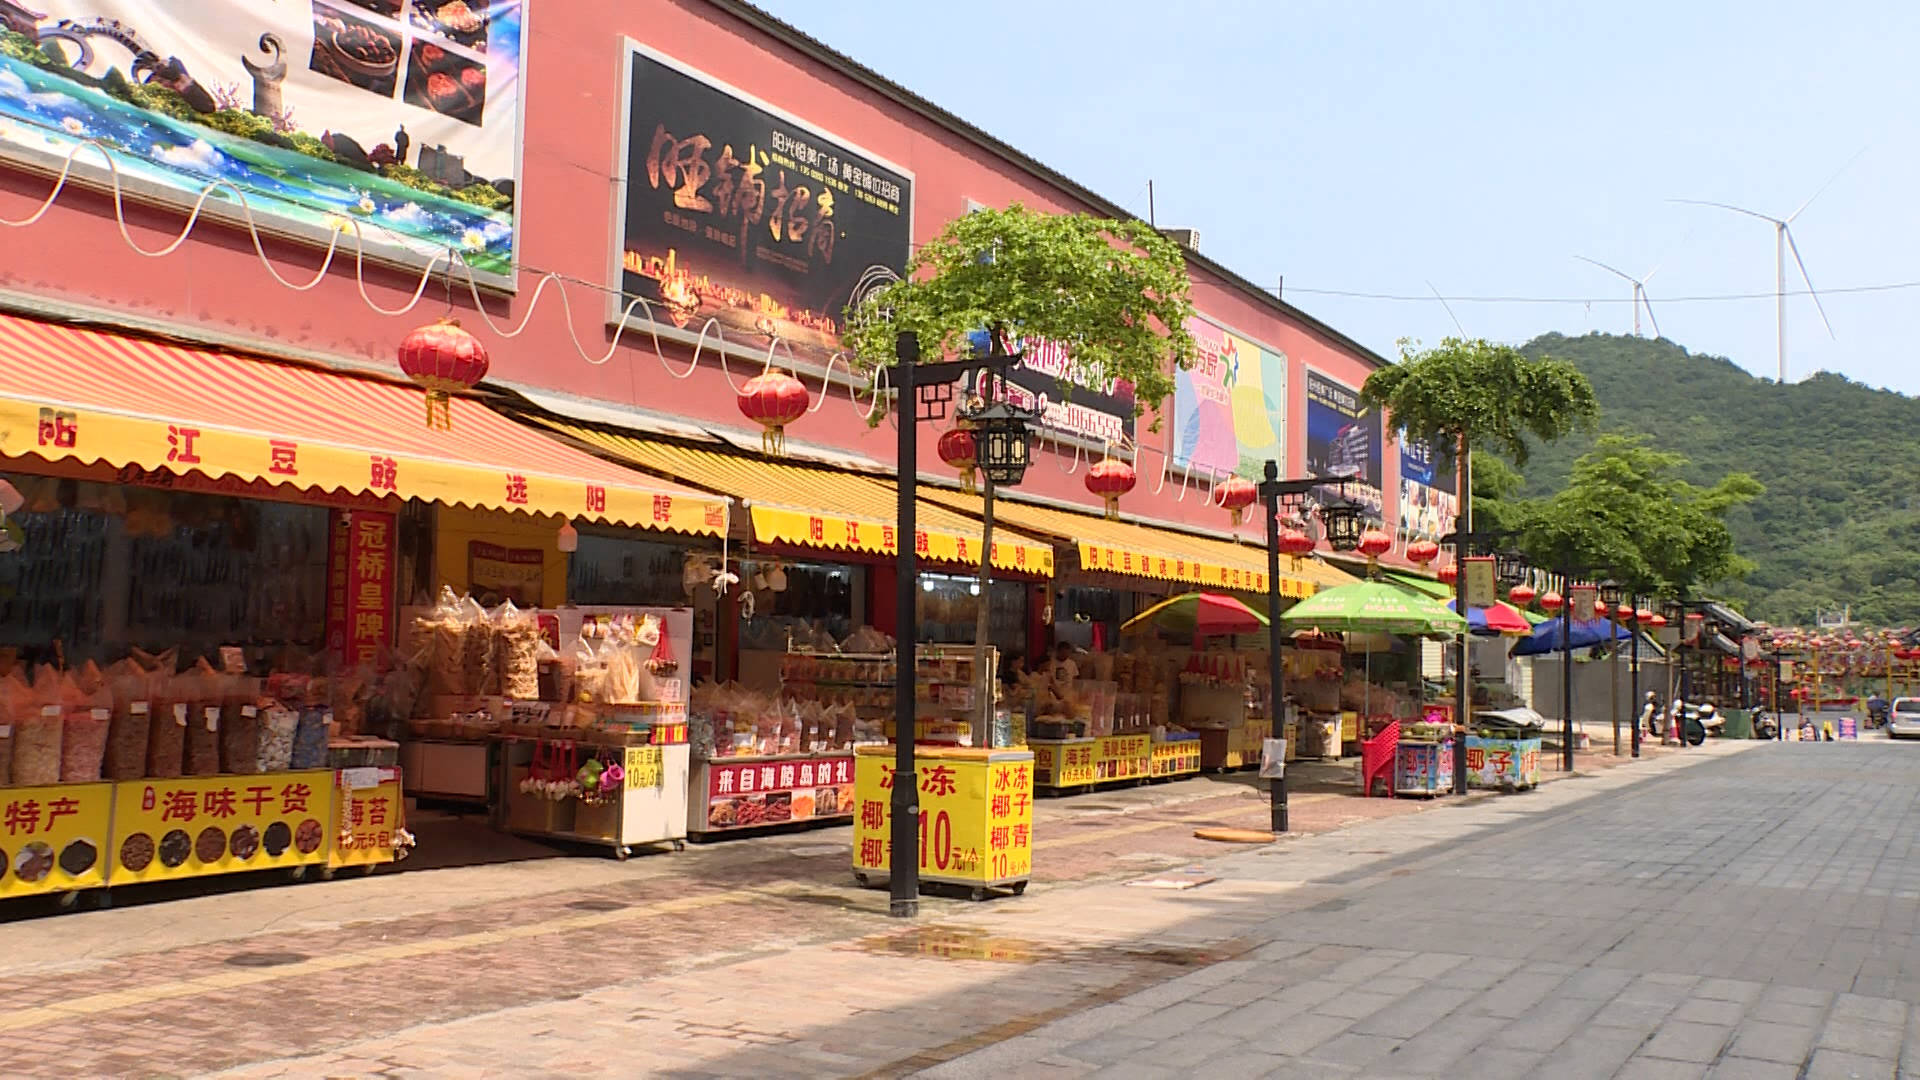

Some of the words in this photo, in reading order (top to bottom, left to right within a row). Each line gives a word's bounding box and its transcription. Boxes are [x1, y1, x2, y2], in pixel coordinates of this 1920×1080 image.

[718, 761, 848, 793] 来自海陵岛的礼
[994, 764, 1029, 791] 冰冻
[4, 797, 80, 836] 特产
[162, 783, 312, 823] 海味干货
[861, 799, 892, 831] 椰
[991, 793, 1030, 819] 椰子
[860, 837, 892, 868] 椰
[990, 823, 1029, 851] 椰青
